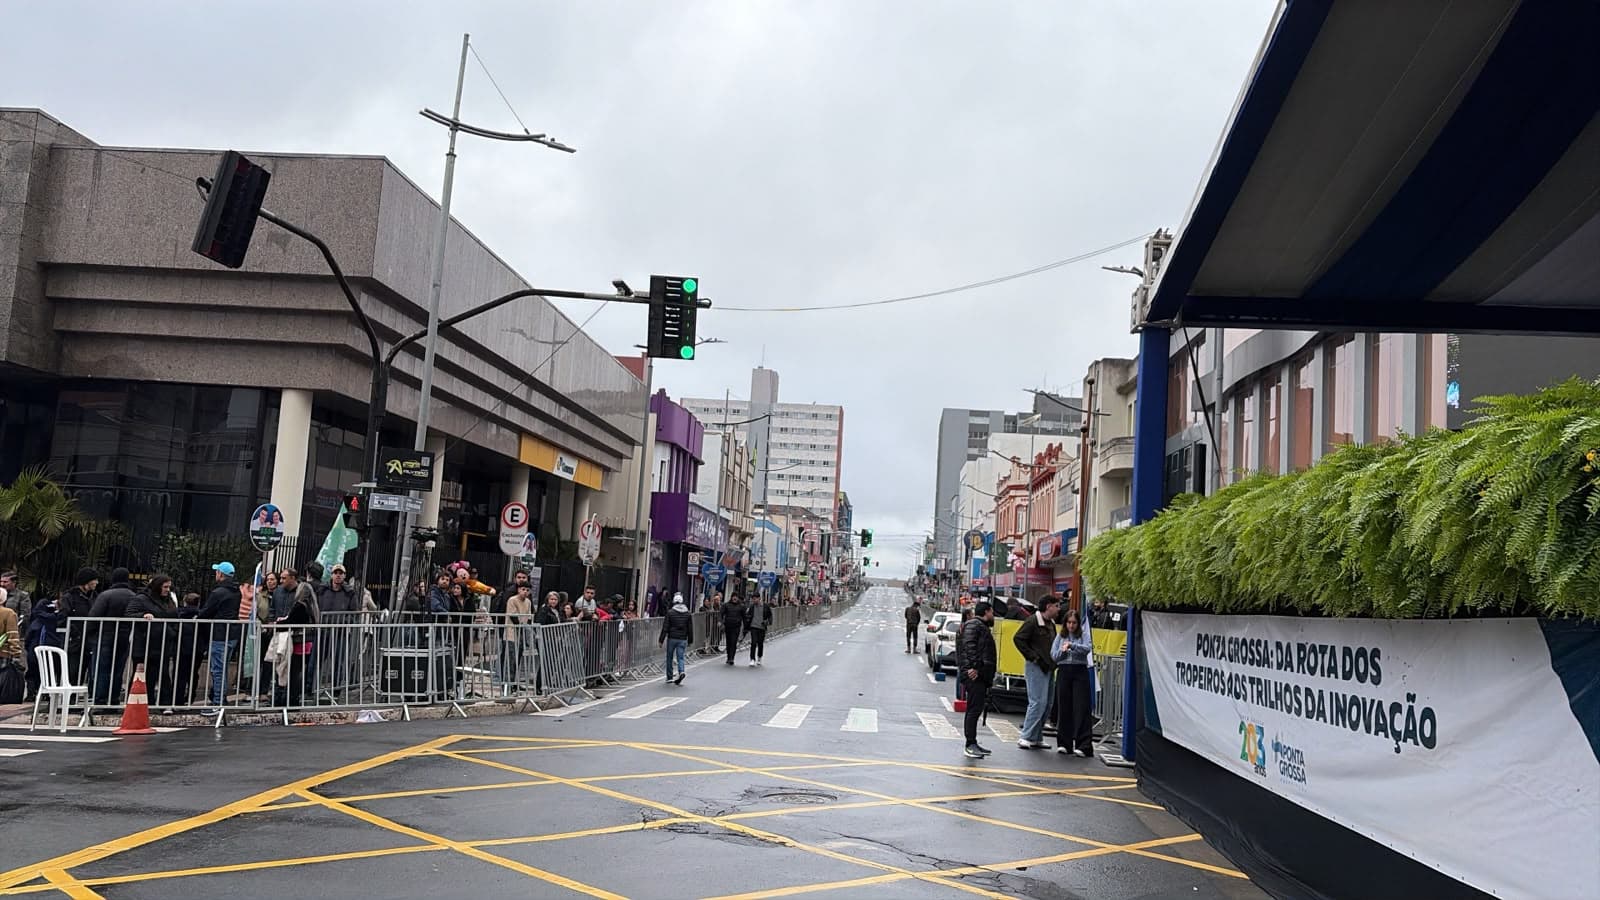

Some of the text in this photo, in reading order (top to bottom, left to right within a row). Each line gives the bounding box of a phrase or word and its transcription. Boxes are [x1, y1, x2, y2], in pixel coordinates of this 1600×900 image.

[510, 508, 521, 523] E
[1196, 633, 1382, 686] PONTA GROSSA: DA ROTA DOS
[1176, 661, 1437, 754] TROPEIROS AOS TRILHOS DA INOVAÇÃO
[1239, 720, 1266, 768] 203
[1283, 744, 1305, 767] PONTA
[1254, 765, 1267, 777] anos
[1279, 760, 1307, 785] GROSSA
